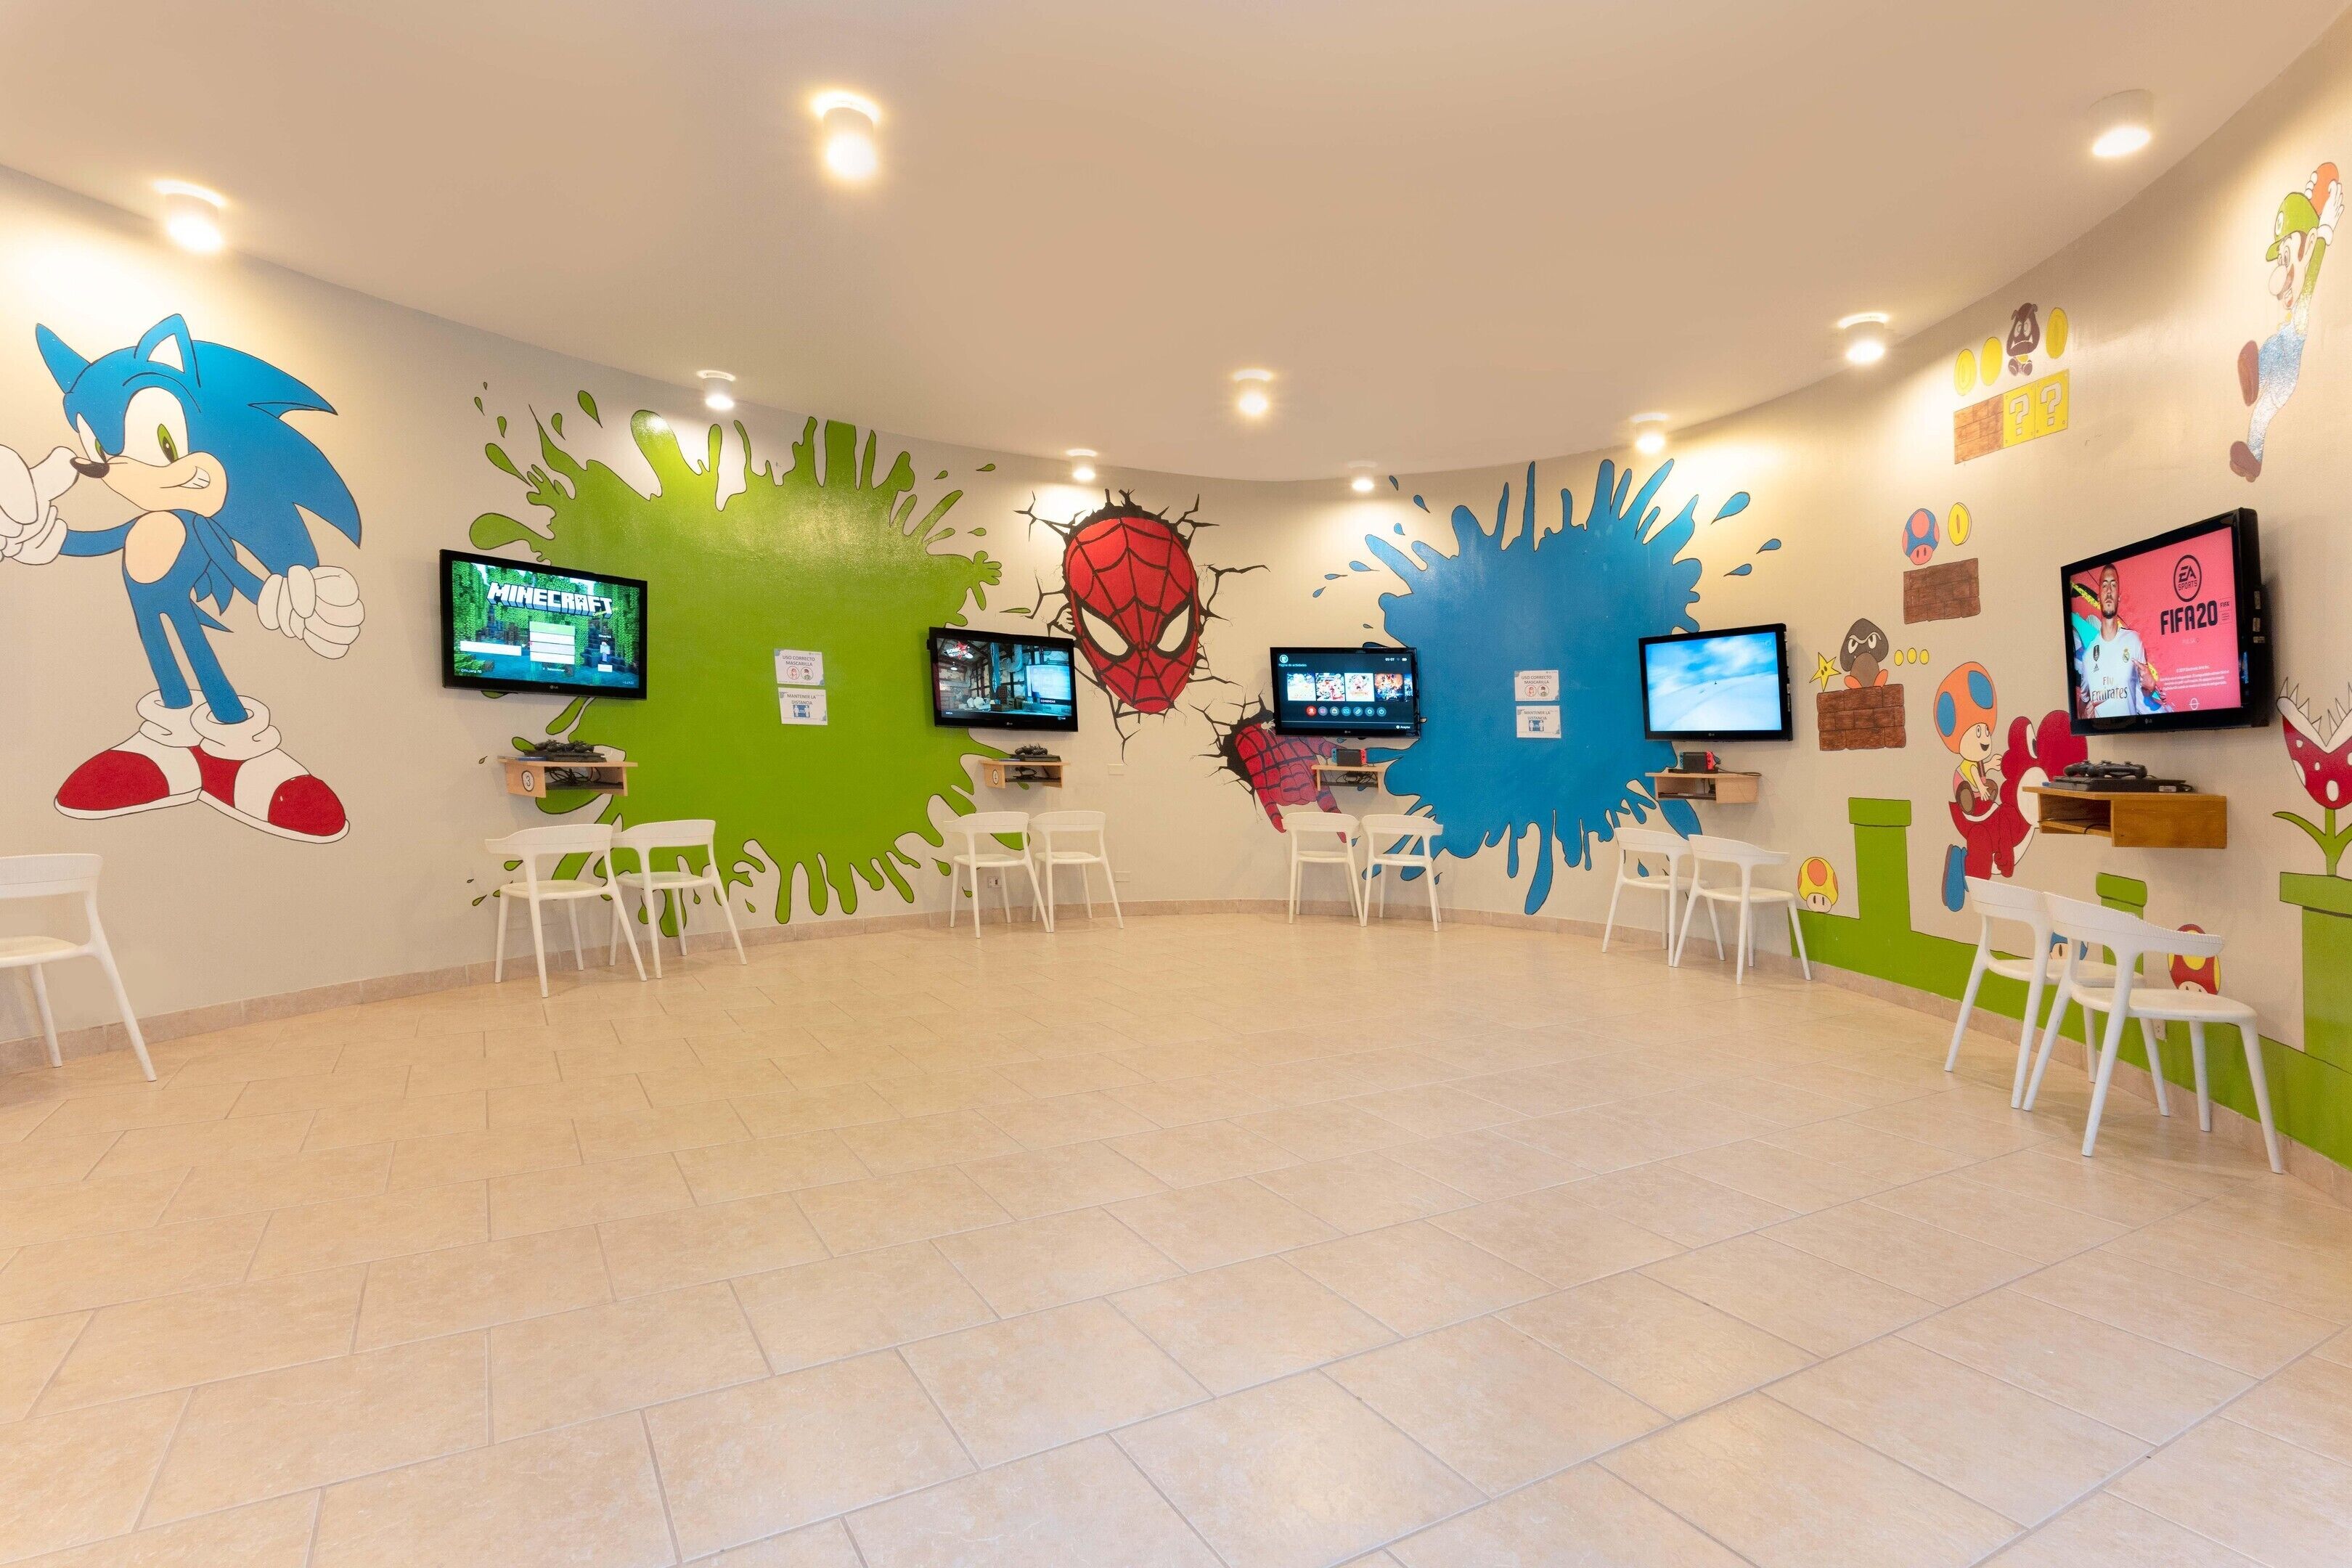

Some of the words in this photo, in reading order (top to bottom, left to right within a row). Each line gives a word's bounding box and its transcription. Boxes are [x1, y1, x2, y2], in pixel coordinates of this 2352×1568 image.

[2179, 565, 2197, 582] EA
[2178, 580, 2197, 591] SPORTS
[487, 581, 613, 618] MINECRAFT
[2102, 676, 2114, 685] Fly
[2091, 687, 2128, 701] Emirates
[526, 775, 531, 787] 3
